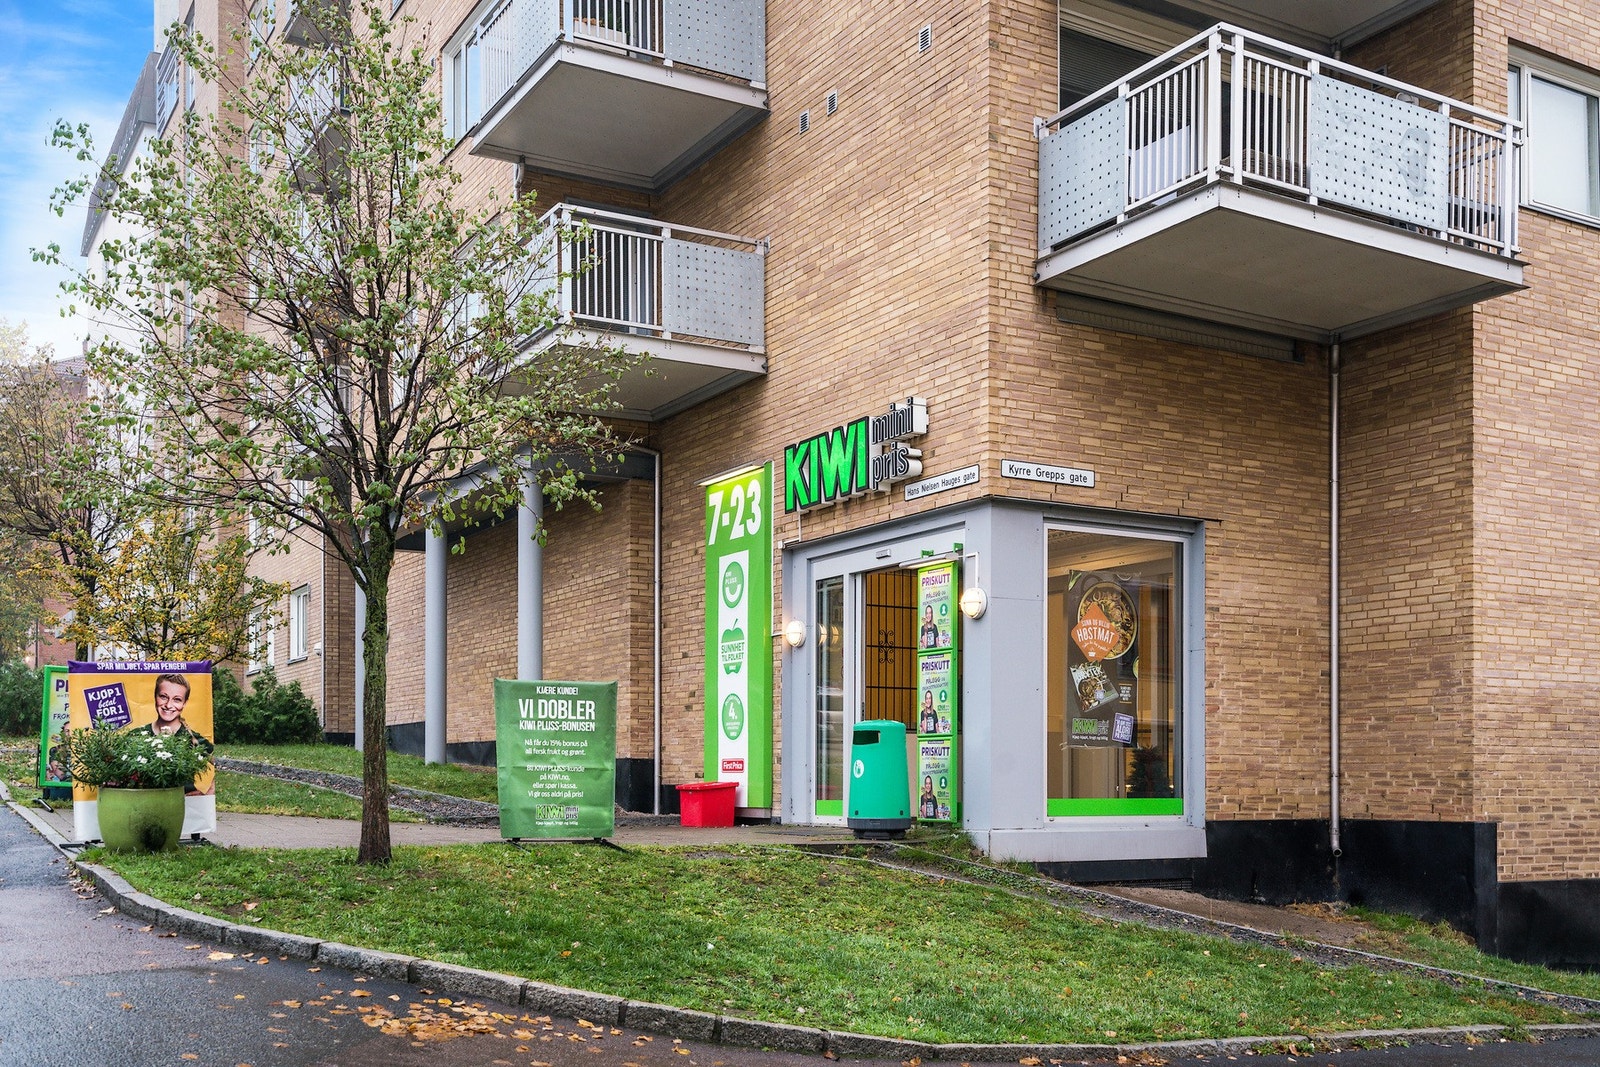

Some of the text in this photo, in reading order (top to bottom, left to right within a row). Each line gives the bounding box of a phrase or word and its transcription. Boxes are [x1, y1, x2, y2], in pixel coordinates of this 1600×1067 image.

[872, 396, 913, 444] mini
[784, 416, 869, 514] KIWI
[872, 442, 909, 491] pris
[1008, 464, 1088, 483] Kyrre Grepps gate
[907, 472, 976, 496] Hans Nielsen Hauges gate
[708, 479, 762, 546] 7-23
[922, 573, 950, 586] PRISKUTT
[1077, 627, 1114, 644] HØSTMAT
[722, 642, 744, 654] SUNNHET
[922, 660, 950, 671] PRISKUTT
[88, 687, 121, 701] KJØP 1
[536, 686, 556, 694] KJÆRE
[98, 697, 117, 708] betal
[518, 699, 596, 720] VI DOBLER
[96, 705, 124, 717] FOR 1
[520, 720, 595, 732] KIWI PLUSS-BONUSEN
[580, 740, 588, 748] på
[922, 747, 950, 756] PRISKUTT
[536, 804, 565, 820] KIWI
